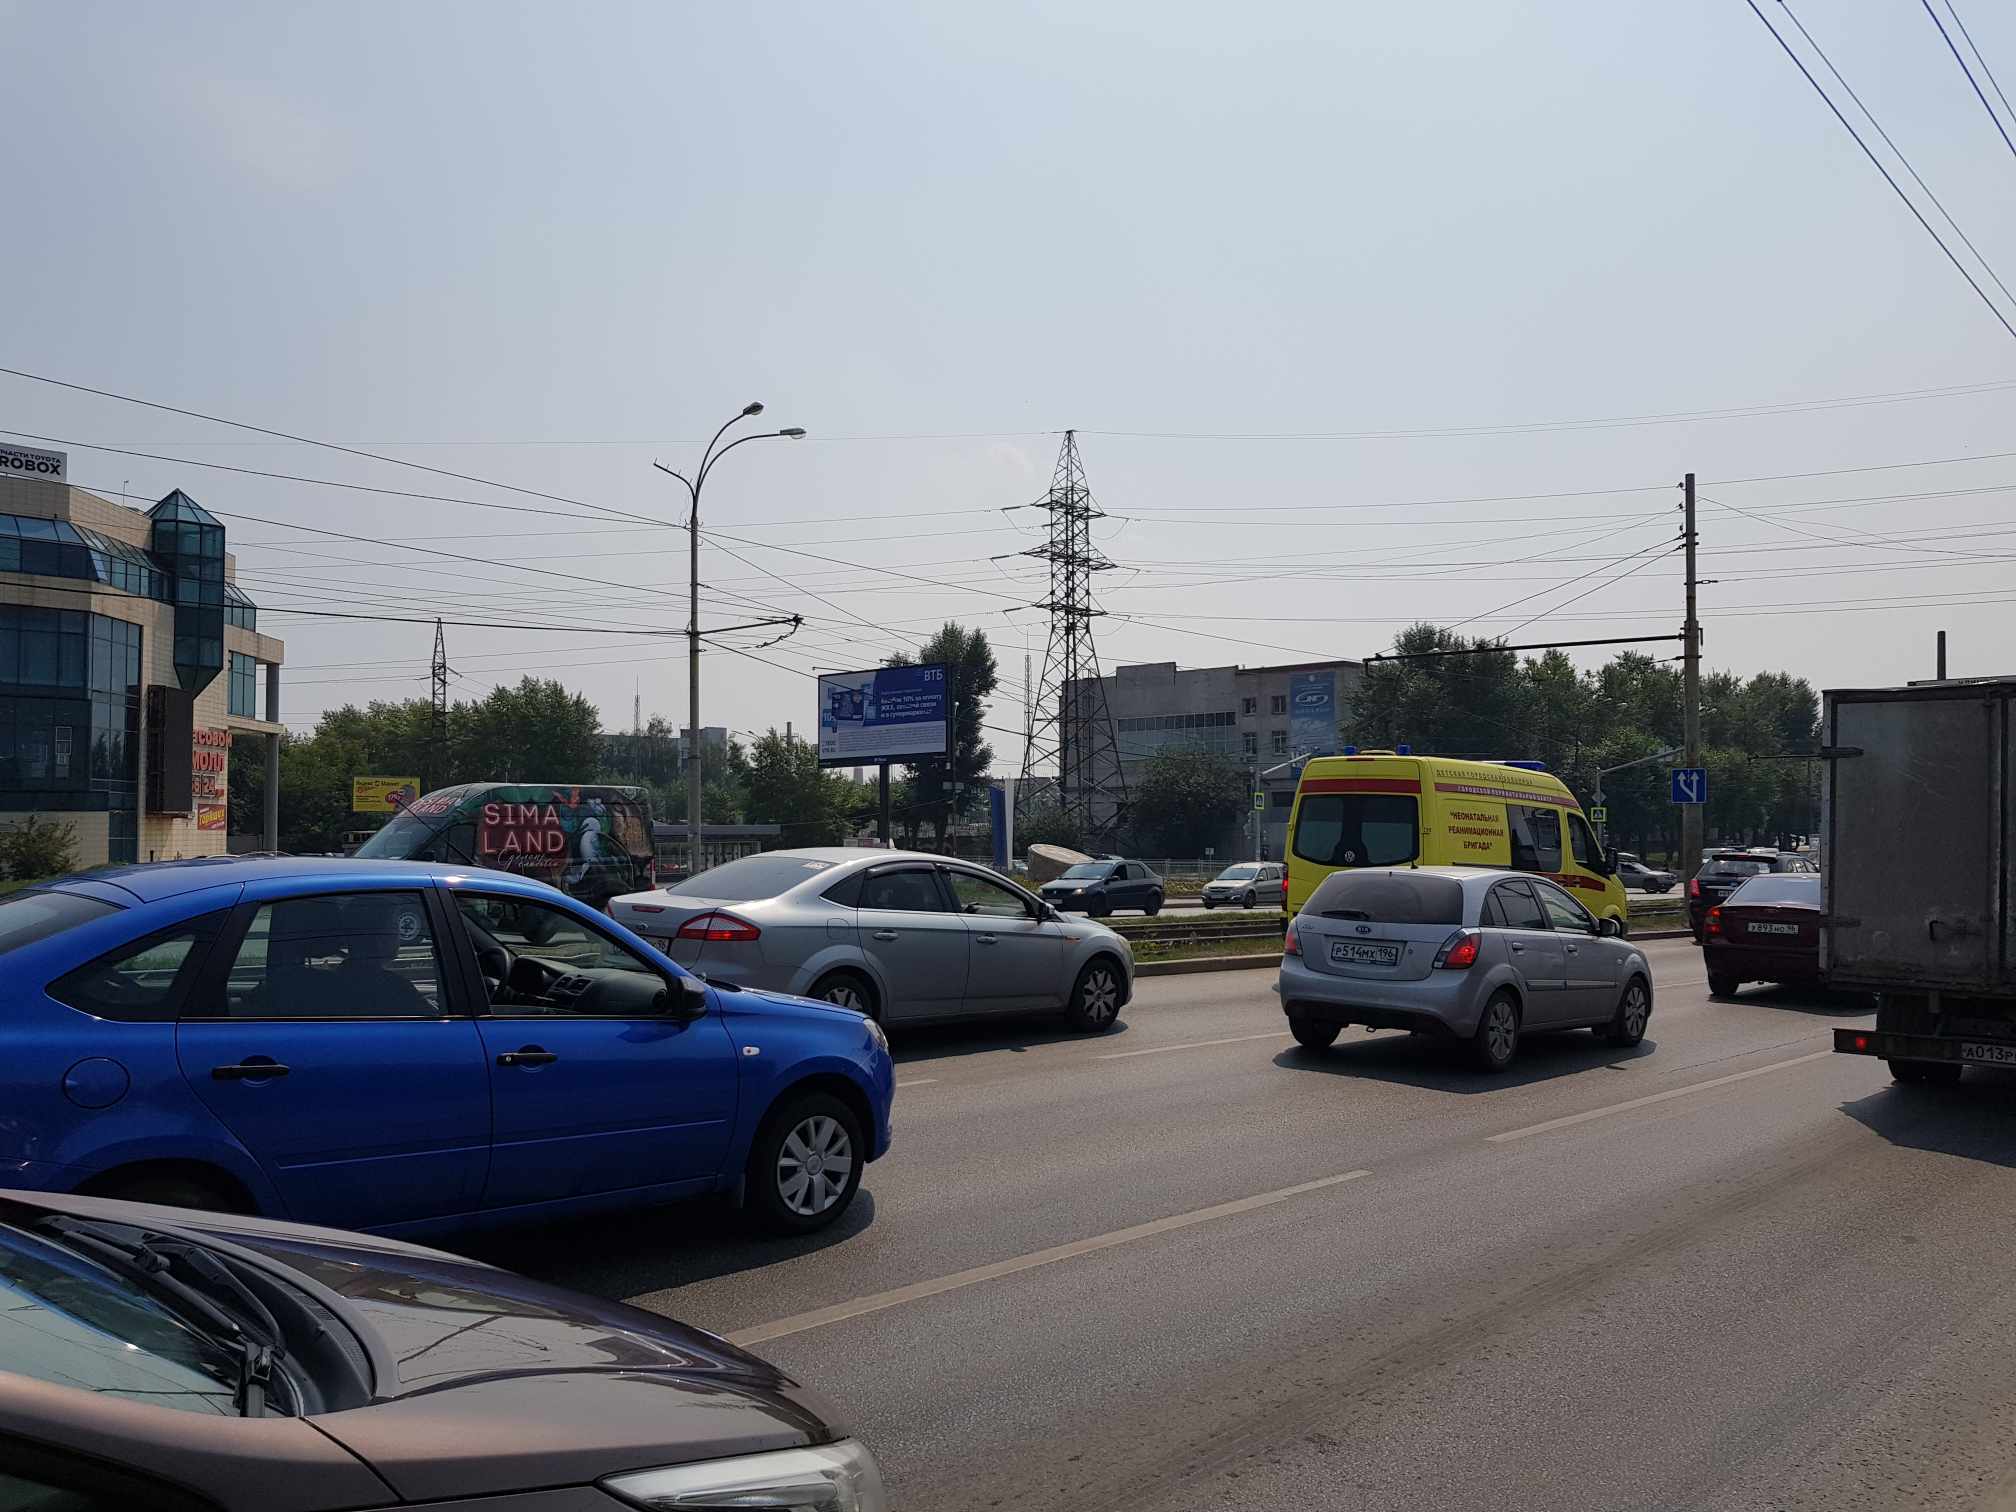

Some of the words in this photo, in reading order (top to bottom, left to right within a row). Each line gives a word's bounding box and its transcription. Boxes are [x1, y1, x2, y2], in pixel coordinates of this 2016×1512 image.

[924, 668, 943, 681] ВТБ
[484, 803, 560, 825] SIMA
[484, 831, 564, 853] LAND
